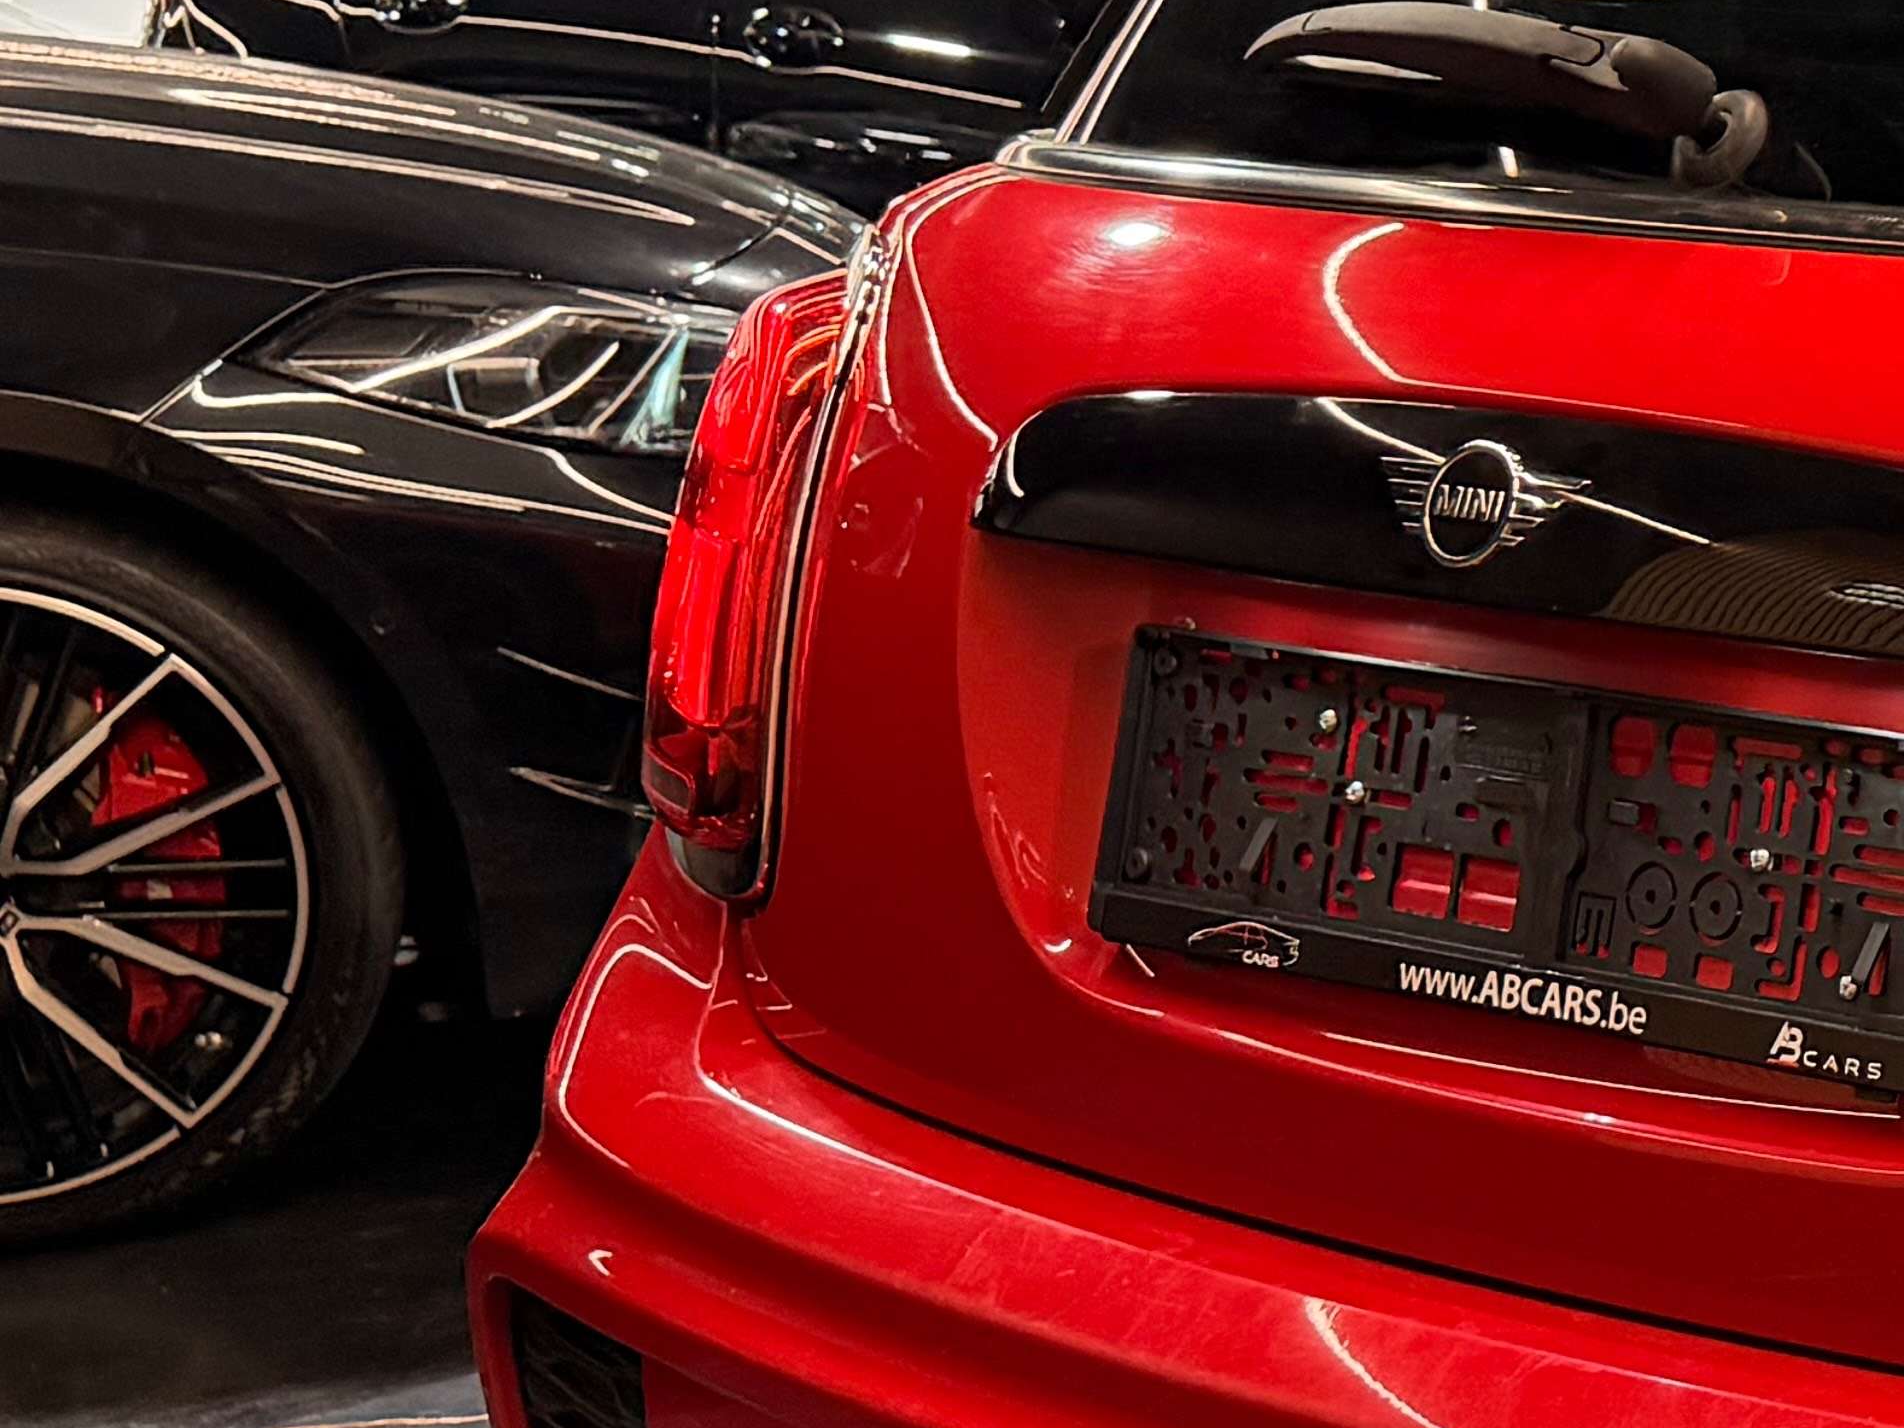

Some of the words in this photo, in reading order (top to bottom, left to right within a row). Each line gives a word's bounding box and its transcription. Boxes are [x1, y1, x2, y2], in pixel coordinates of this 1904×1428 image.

[1433, 483, 1506, 523] MINI
[1399, 962, 1648, 1035] www.ABCARS.be
[1803, 1050, 1882, 1080] CARS
